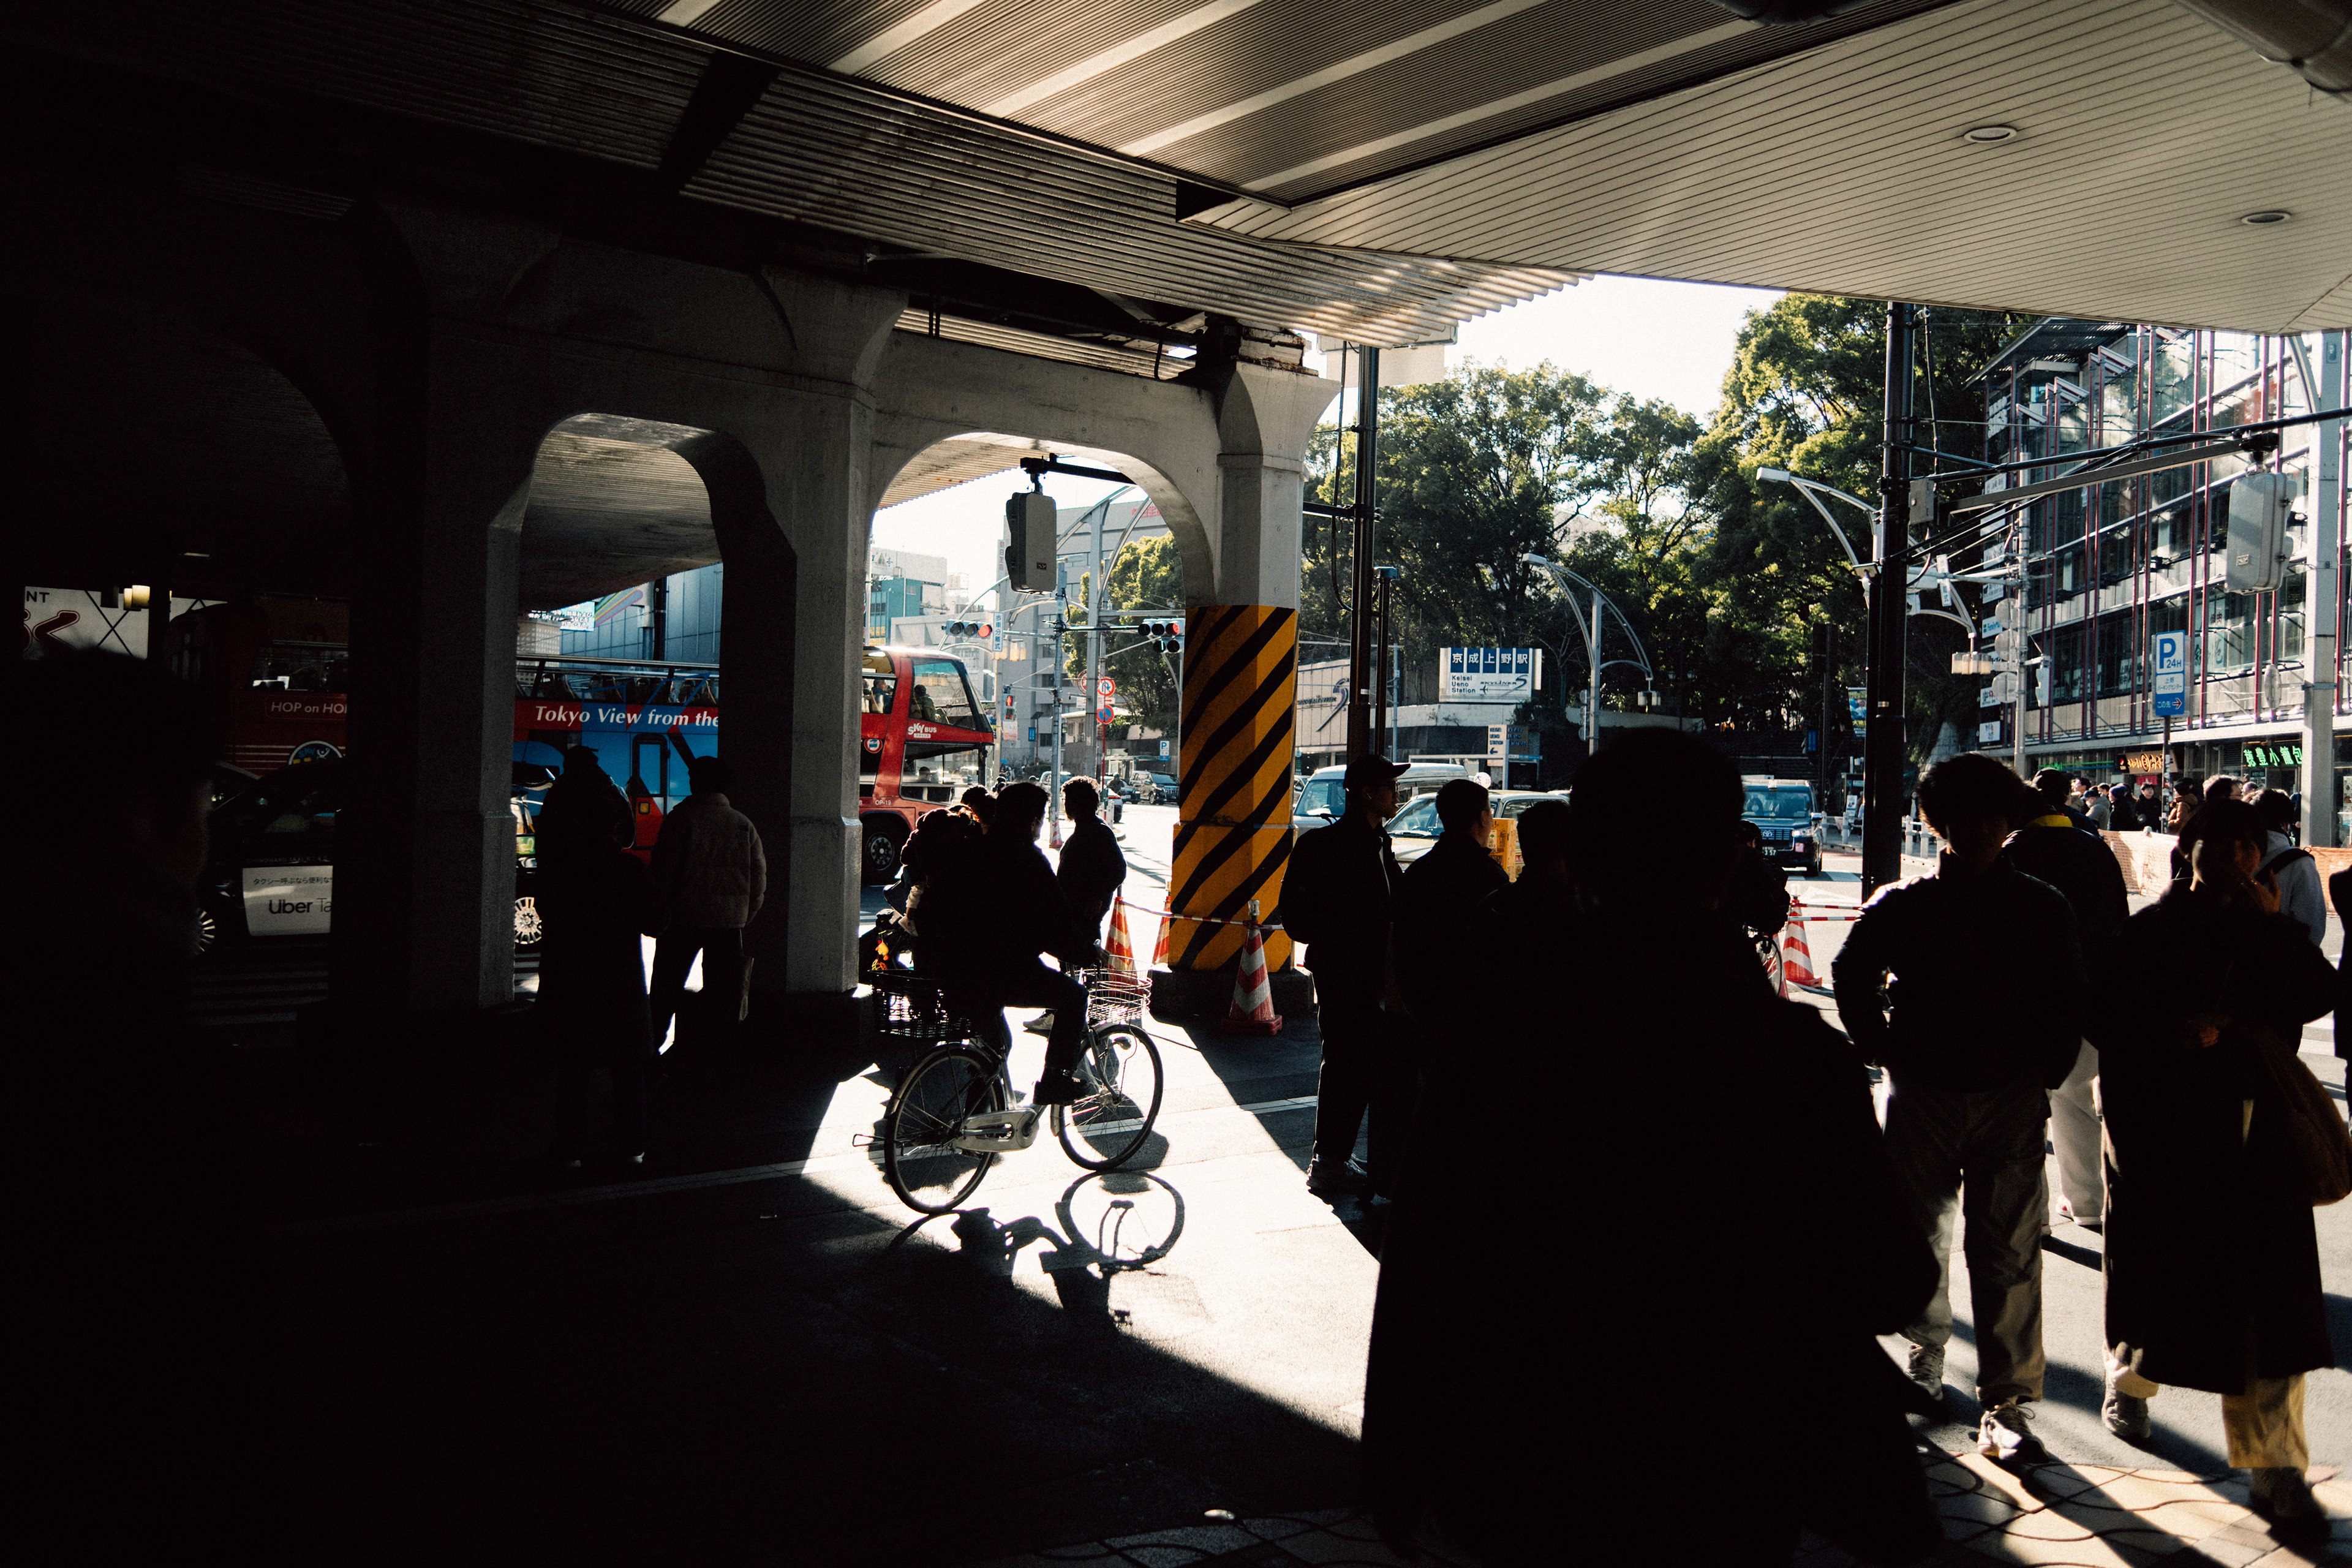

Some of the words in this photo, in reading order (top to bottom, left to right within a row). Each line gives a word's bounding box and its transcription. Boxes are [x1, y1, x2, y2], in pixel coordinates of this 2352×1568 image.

[1452, 652, 1528, 665] 京成上野駅
[2159, 638, 2176, 669] P
[2166, 658, 2182, 669] 24H
[271, 701, 303, 712] HOP
[323, 703, 347, 714] HO
[2157, 700, 2171, 709] この先
[535, 705, 590, 727] Tokyo
[598, 707, 642, 724] View
[647, 709, 689, 726] from
[695, 710, 718, 727] the
[908, 722, 925, 735] SKY
[254, 876, 333, 886] タクシー呼ぶなら便利な
[269, 899, 314, 914] Uber
